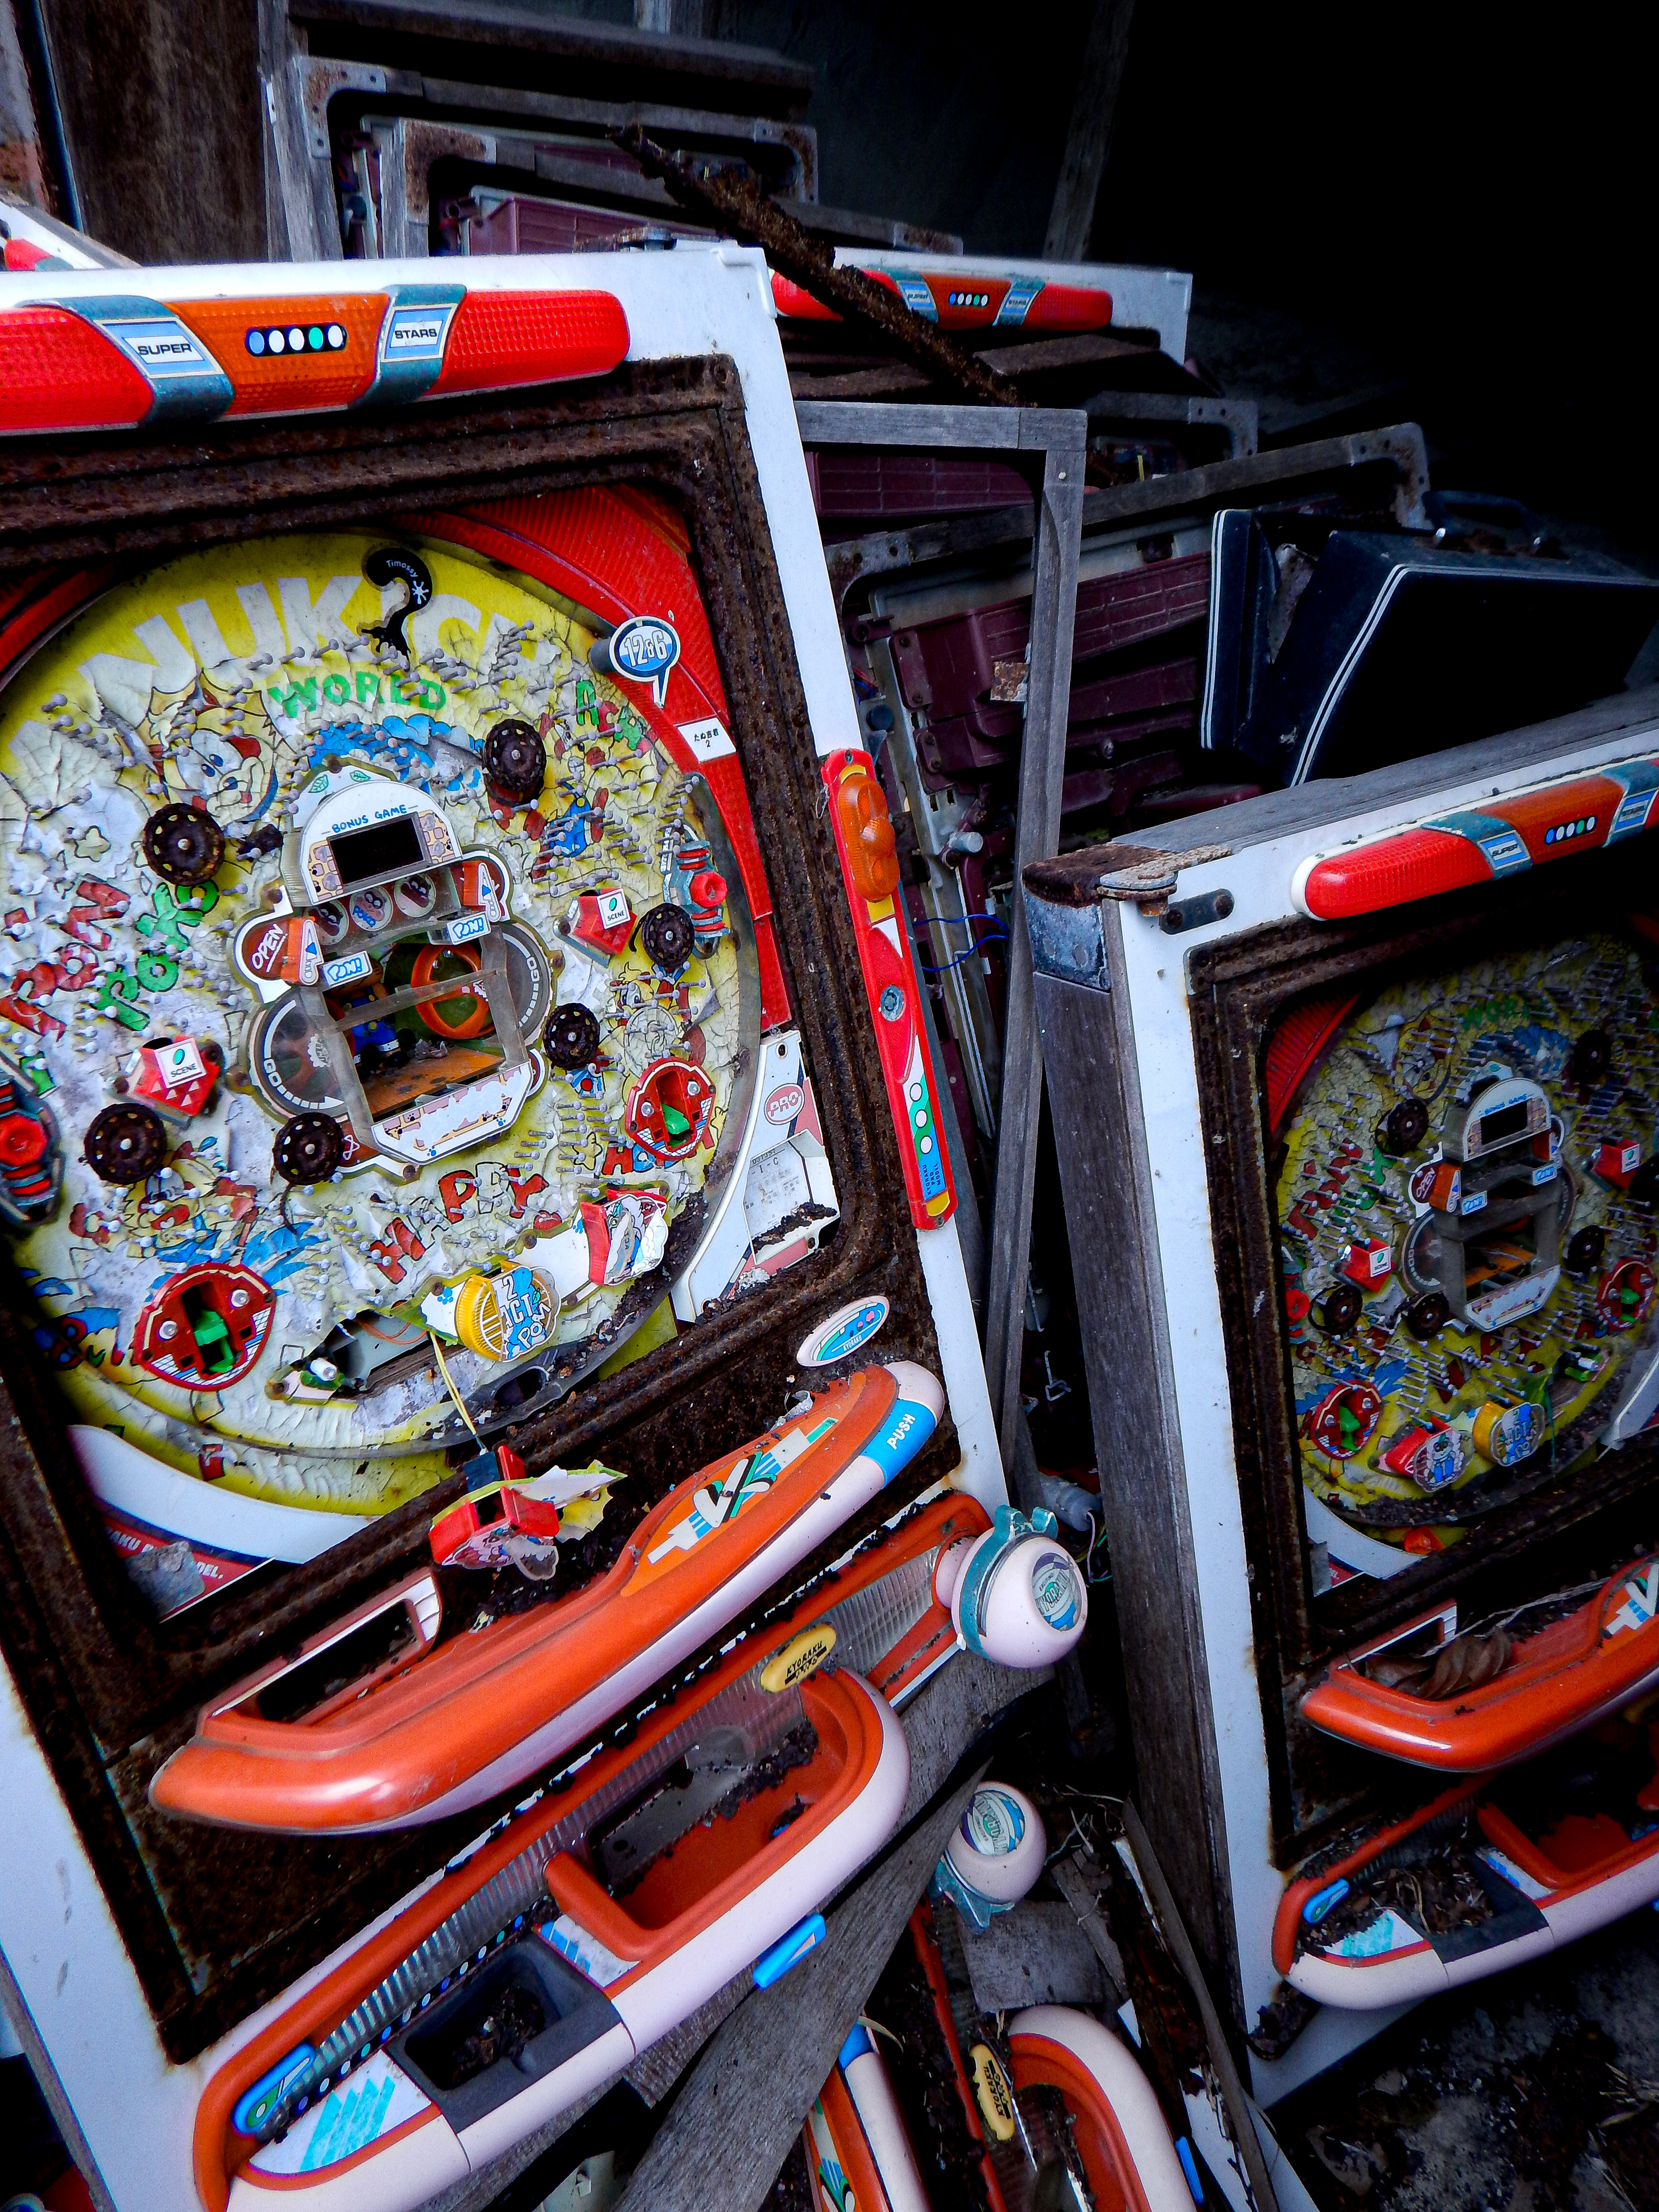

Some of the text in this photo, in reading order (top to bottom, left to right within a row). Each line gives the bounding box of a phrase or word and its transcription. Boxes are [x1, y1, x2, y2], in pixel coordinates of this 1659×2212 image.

[394, 327, 437, 339] STARS
[137, 342, 192, 356] SUPER
[624, 630, 667, 667] 12&6
[705, 739, 710, 748] 2
[331, 804, 407, 834] BONUS GAME
[1491, 844, 1519, 858] SUPER
[607, 910, 625, 922] SCENE
[453, 917, 484, 939] PON!
[252, 923, 284, 969] OPEN
[327, 957, 362, 981] PON!
[170, 1063, 197, 1078] SCENE
[769, 1092, 801, 1117] PRO
[922, 1164, 932, 1196] KYORAKU
[502, 1274, 518, 1301] 2
[842, 1334, 863, 1352] KYORAKU
[786, 1640, 822, 1677] KYORAKU
